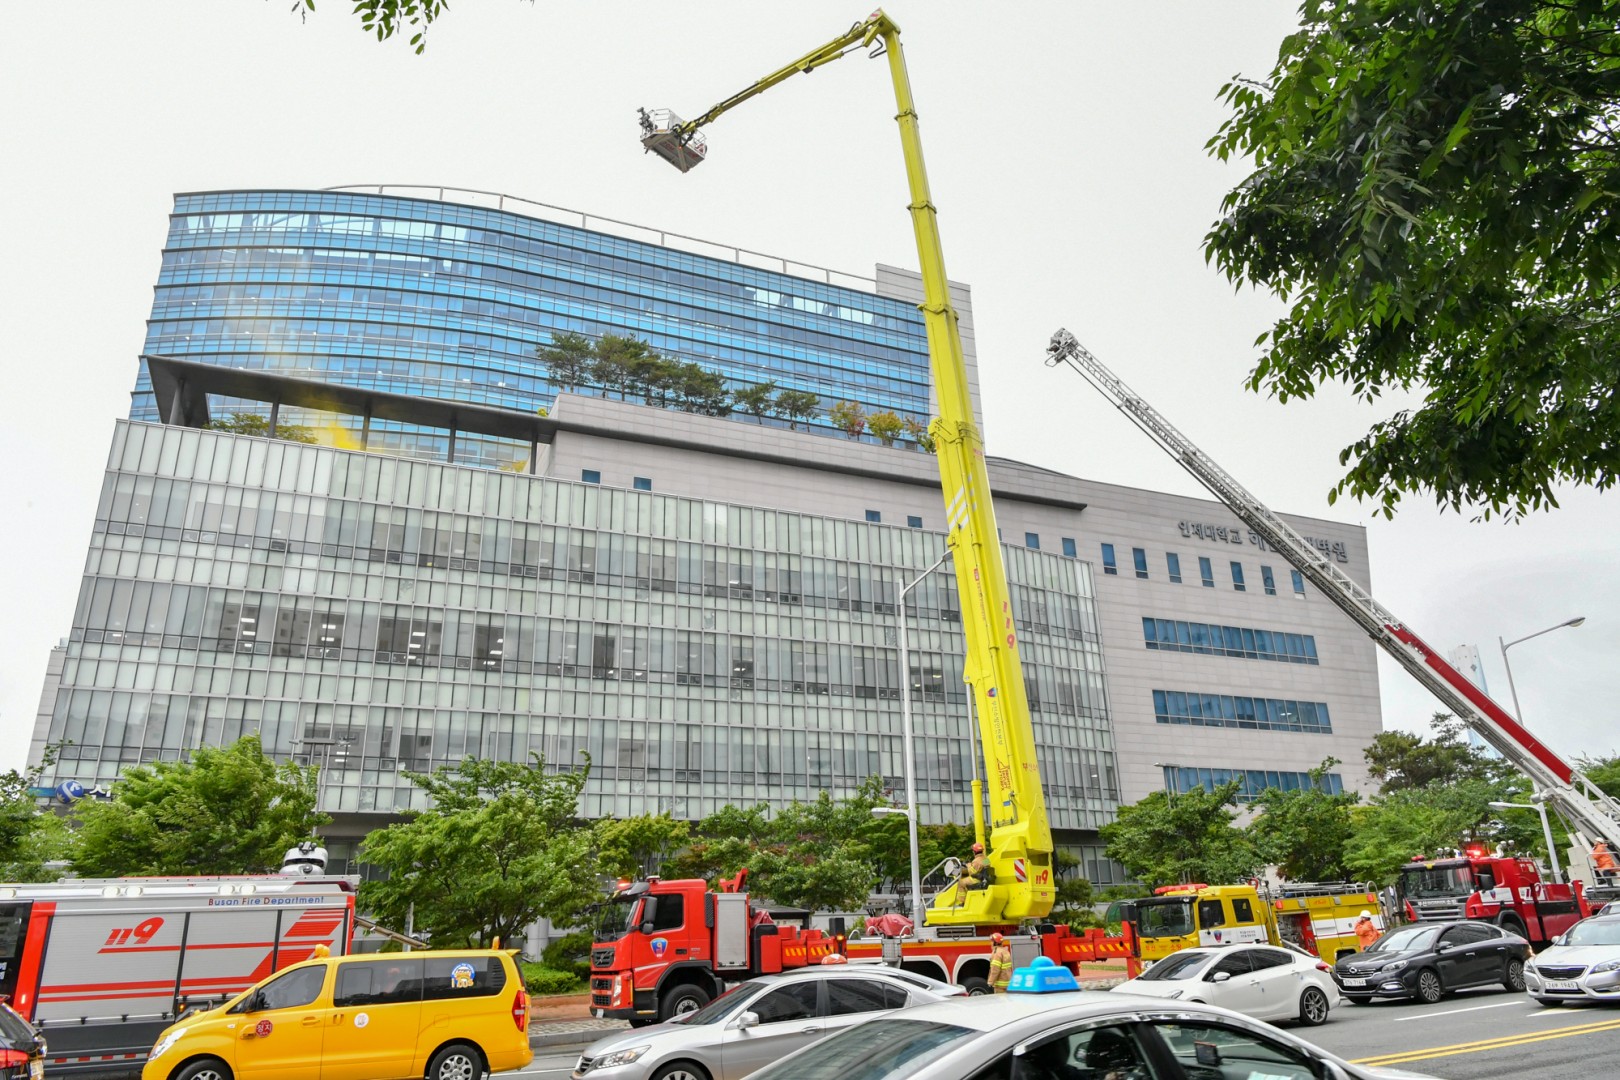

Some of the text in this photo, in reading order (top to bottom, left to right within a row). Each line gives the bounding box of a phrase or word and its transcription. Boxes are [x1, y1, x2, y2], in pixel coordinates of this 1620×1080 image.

[1178, 521, 1243, 544] 인제대학교
[1036, 869, 1049, 885] 119
[208, 896, 324, 906] Busan Fire Department
[104, 917, 165, 946] 119
